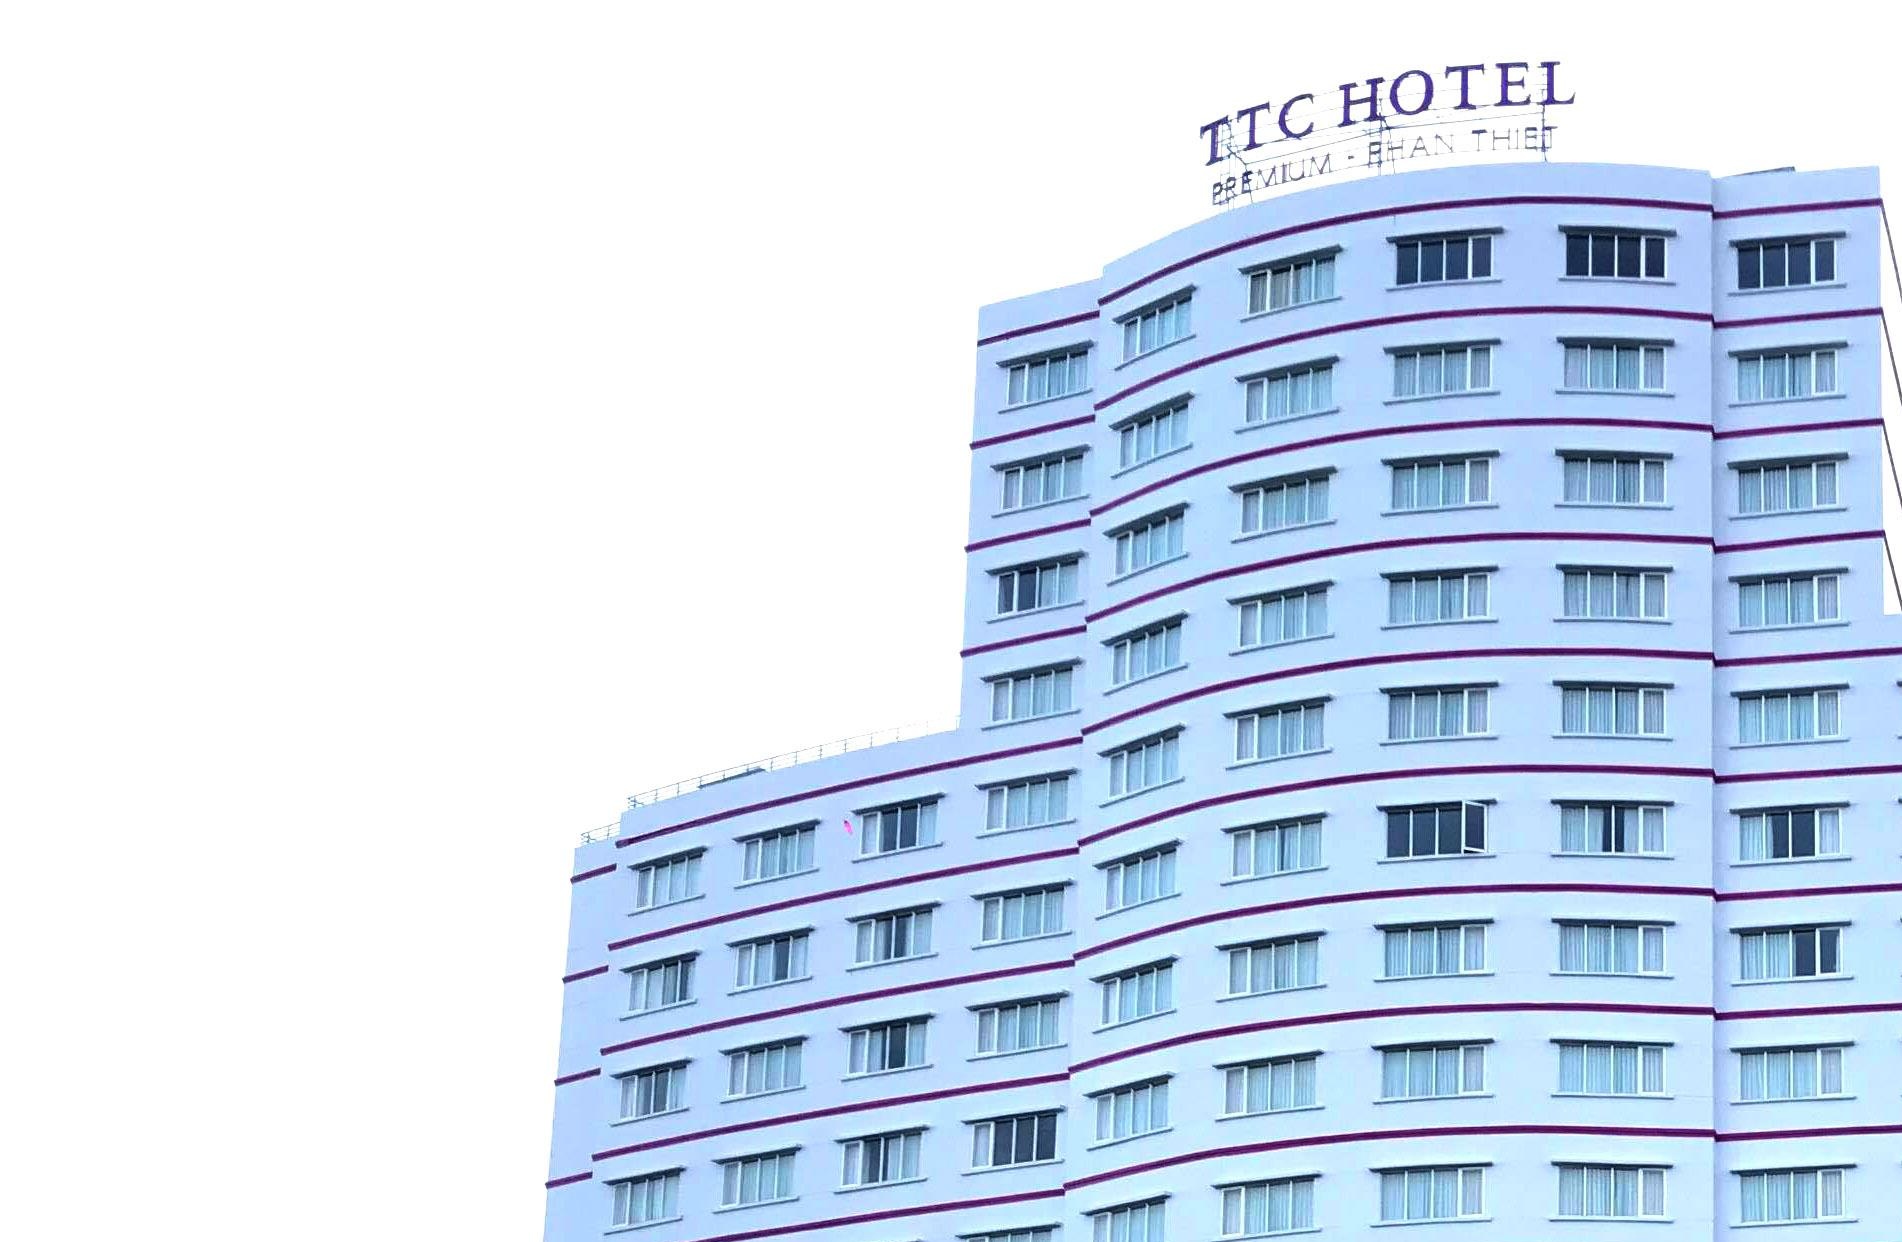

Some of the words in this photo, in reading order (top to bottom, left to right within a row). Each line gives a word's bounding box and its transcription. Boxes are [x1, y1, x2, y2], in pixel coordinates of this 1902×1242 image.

[1200, 93, 1315, 166] TTC
[1337, 61, 1577, 128] HOTEL
[1212, 152, 1335, 206] PREMIUM
